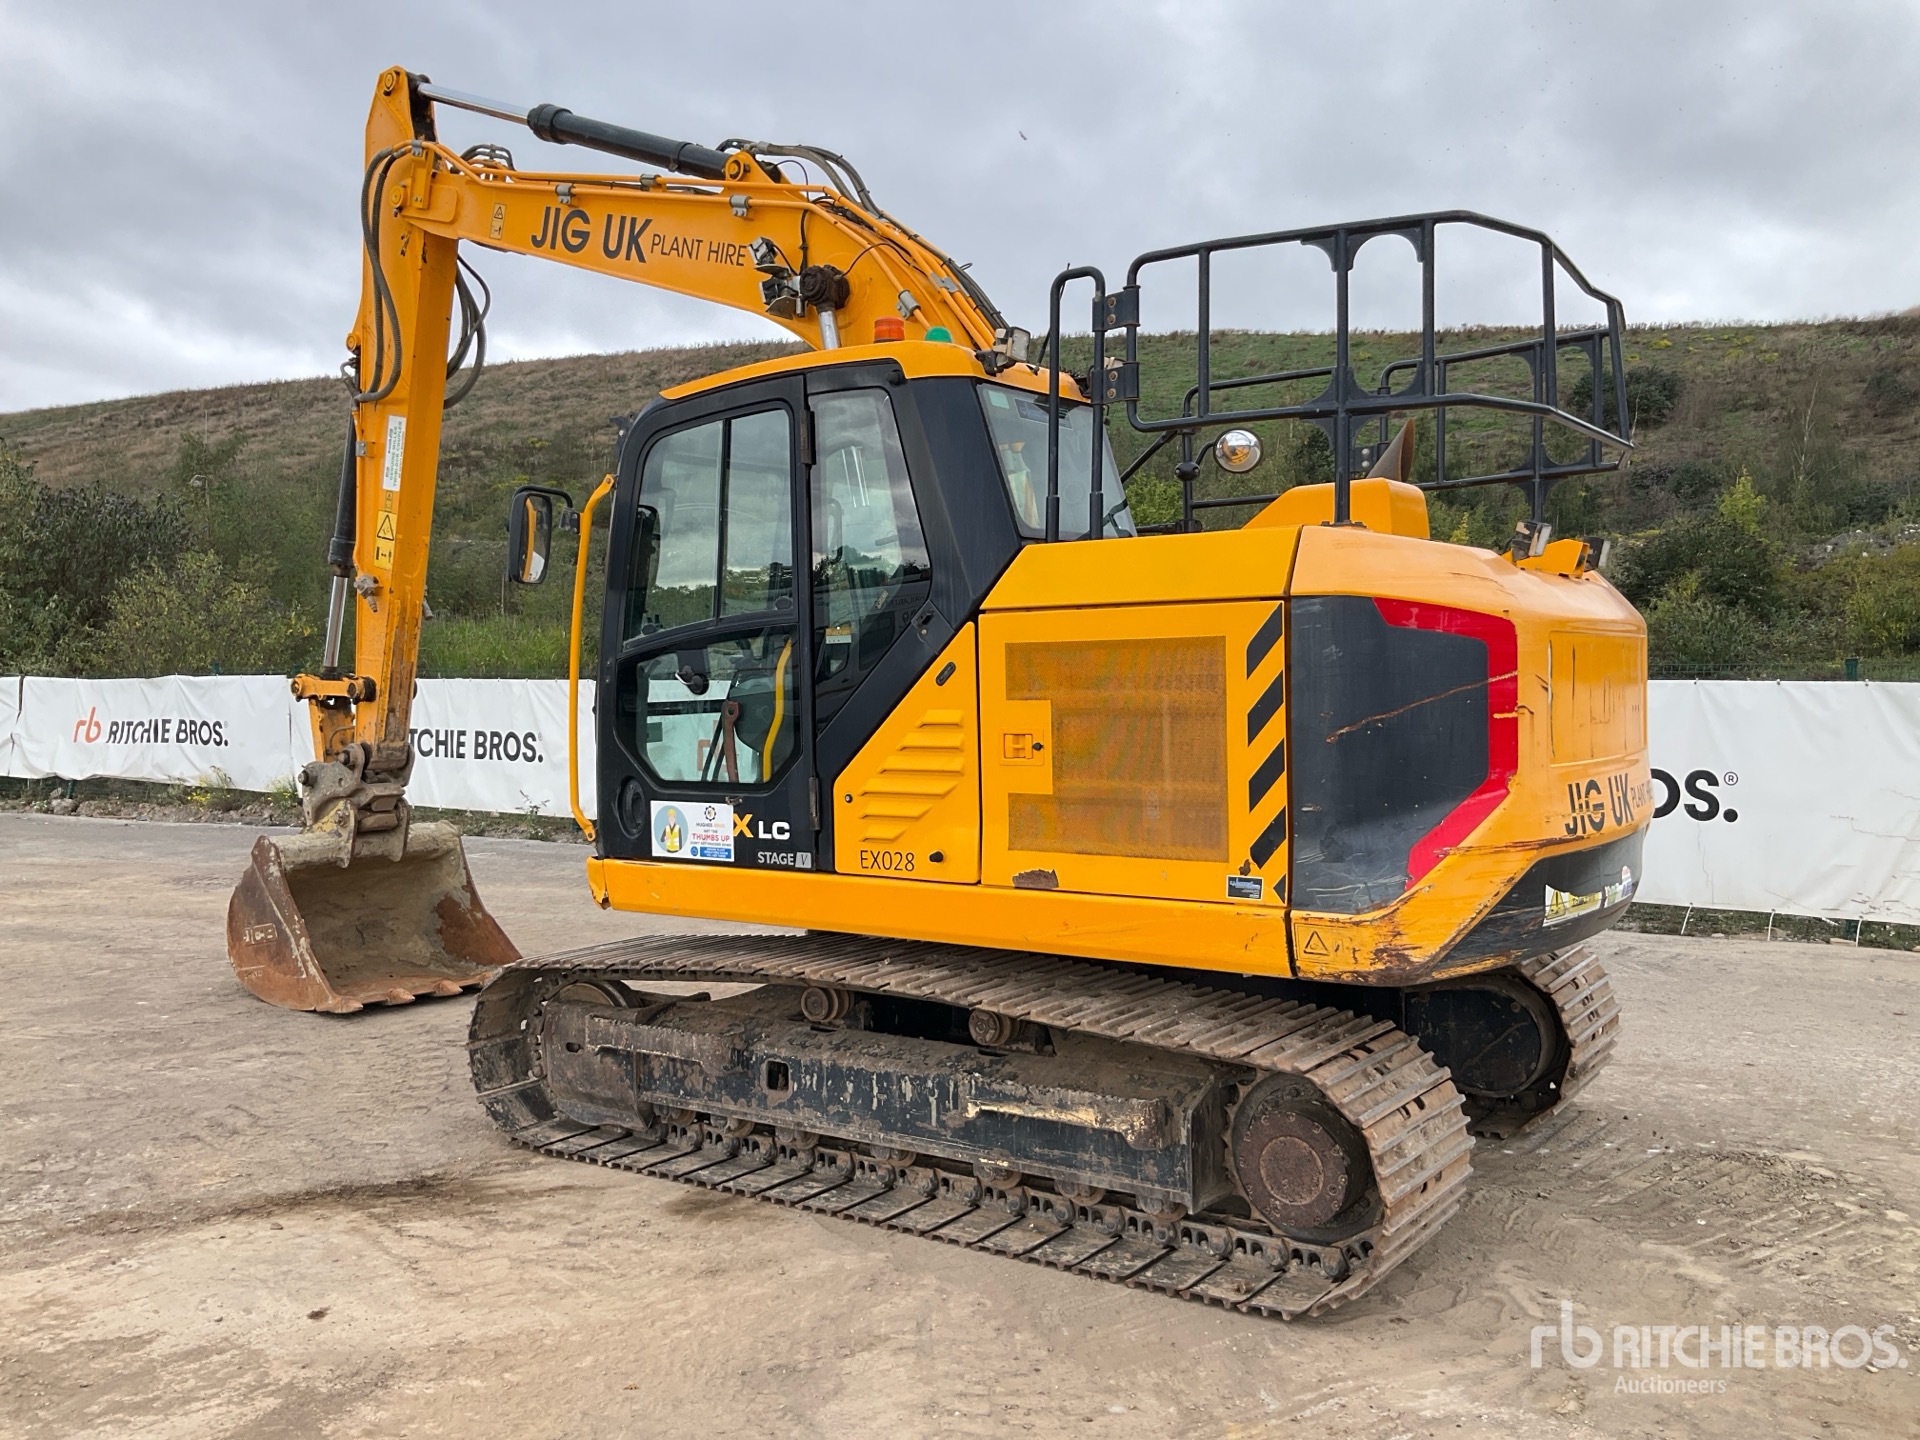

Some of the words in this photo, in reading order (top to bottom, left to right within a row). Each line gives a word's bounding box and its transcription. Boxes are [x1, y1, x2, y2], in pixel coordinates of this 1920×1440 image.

[531, 205, 590, 253] JIG
[603, 213, 652, 263] UK
[650, 232, 704, 260] PLANT
[706, 241, 747, 267] HIRE
[73, 706, 102, 743] rb
[106, 718, 171, 744] RITCHIE
[176, 719, 229, 746] BROS.
[409, 728, 467, 759] TCHIE
[474, 730, 543, 763] BROS.
[1565, 779, 1605, 836] JIG
[1607, 772, 1634, 827] UK
[692, 833, 719, 842] THUMBS
[758, 820, 791, 841] LC
[757, 851, 794, 866] STAGE
[860, 850, 915, 872] EX028
